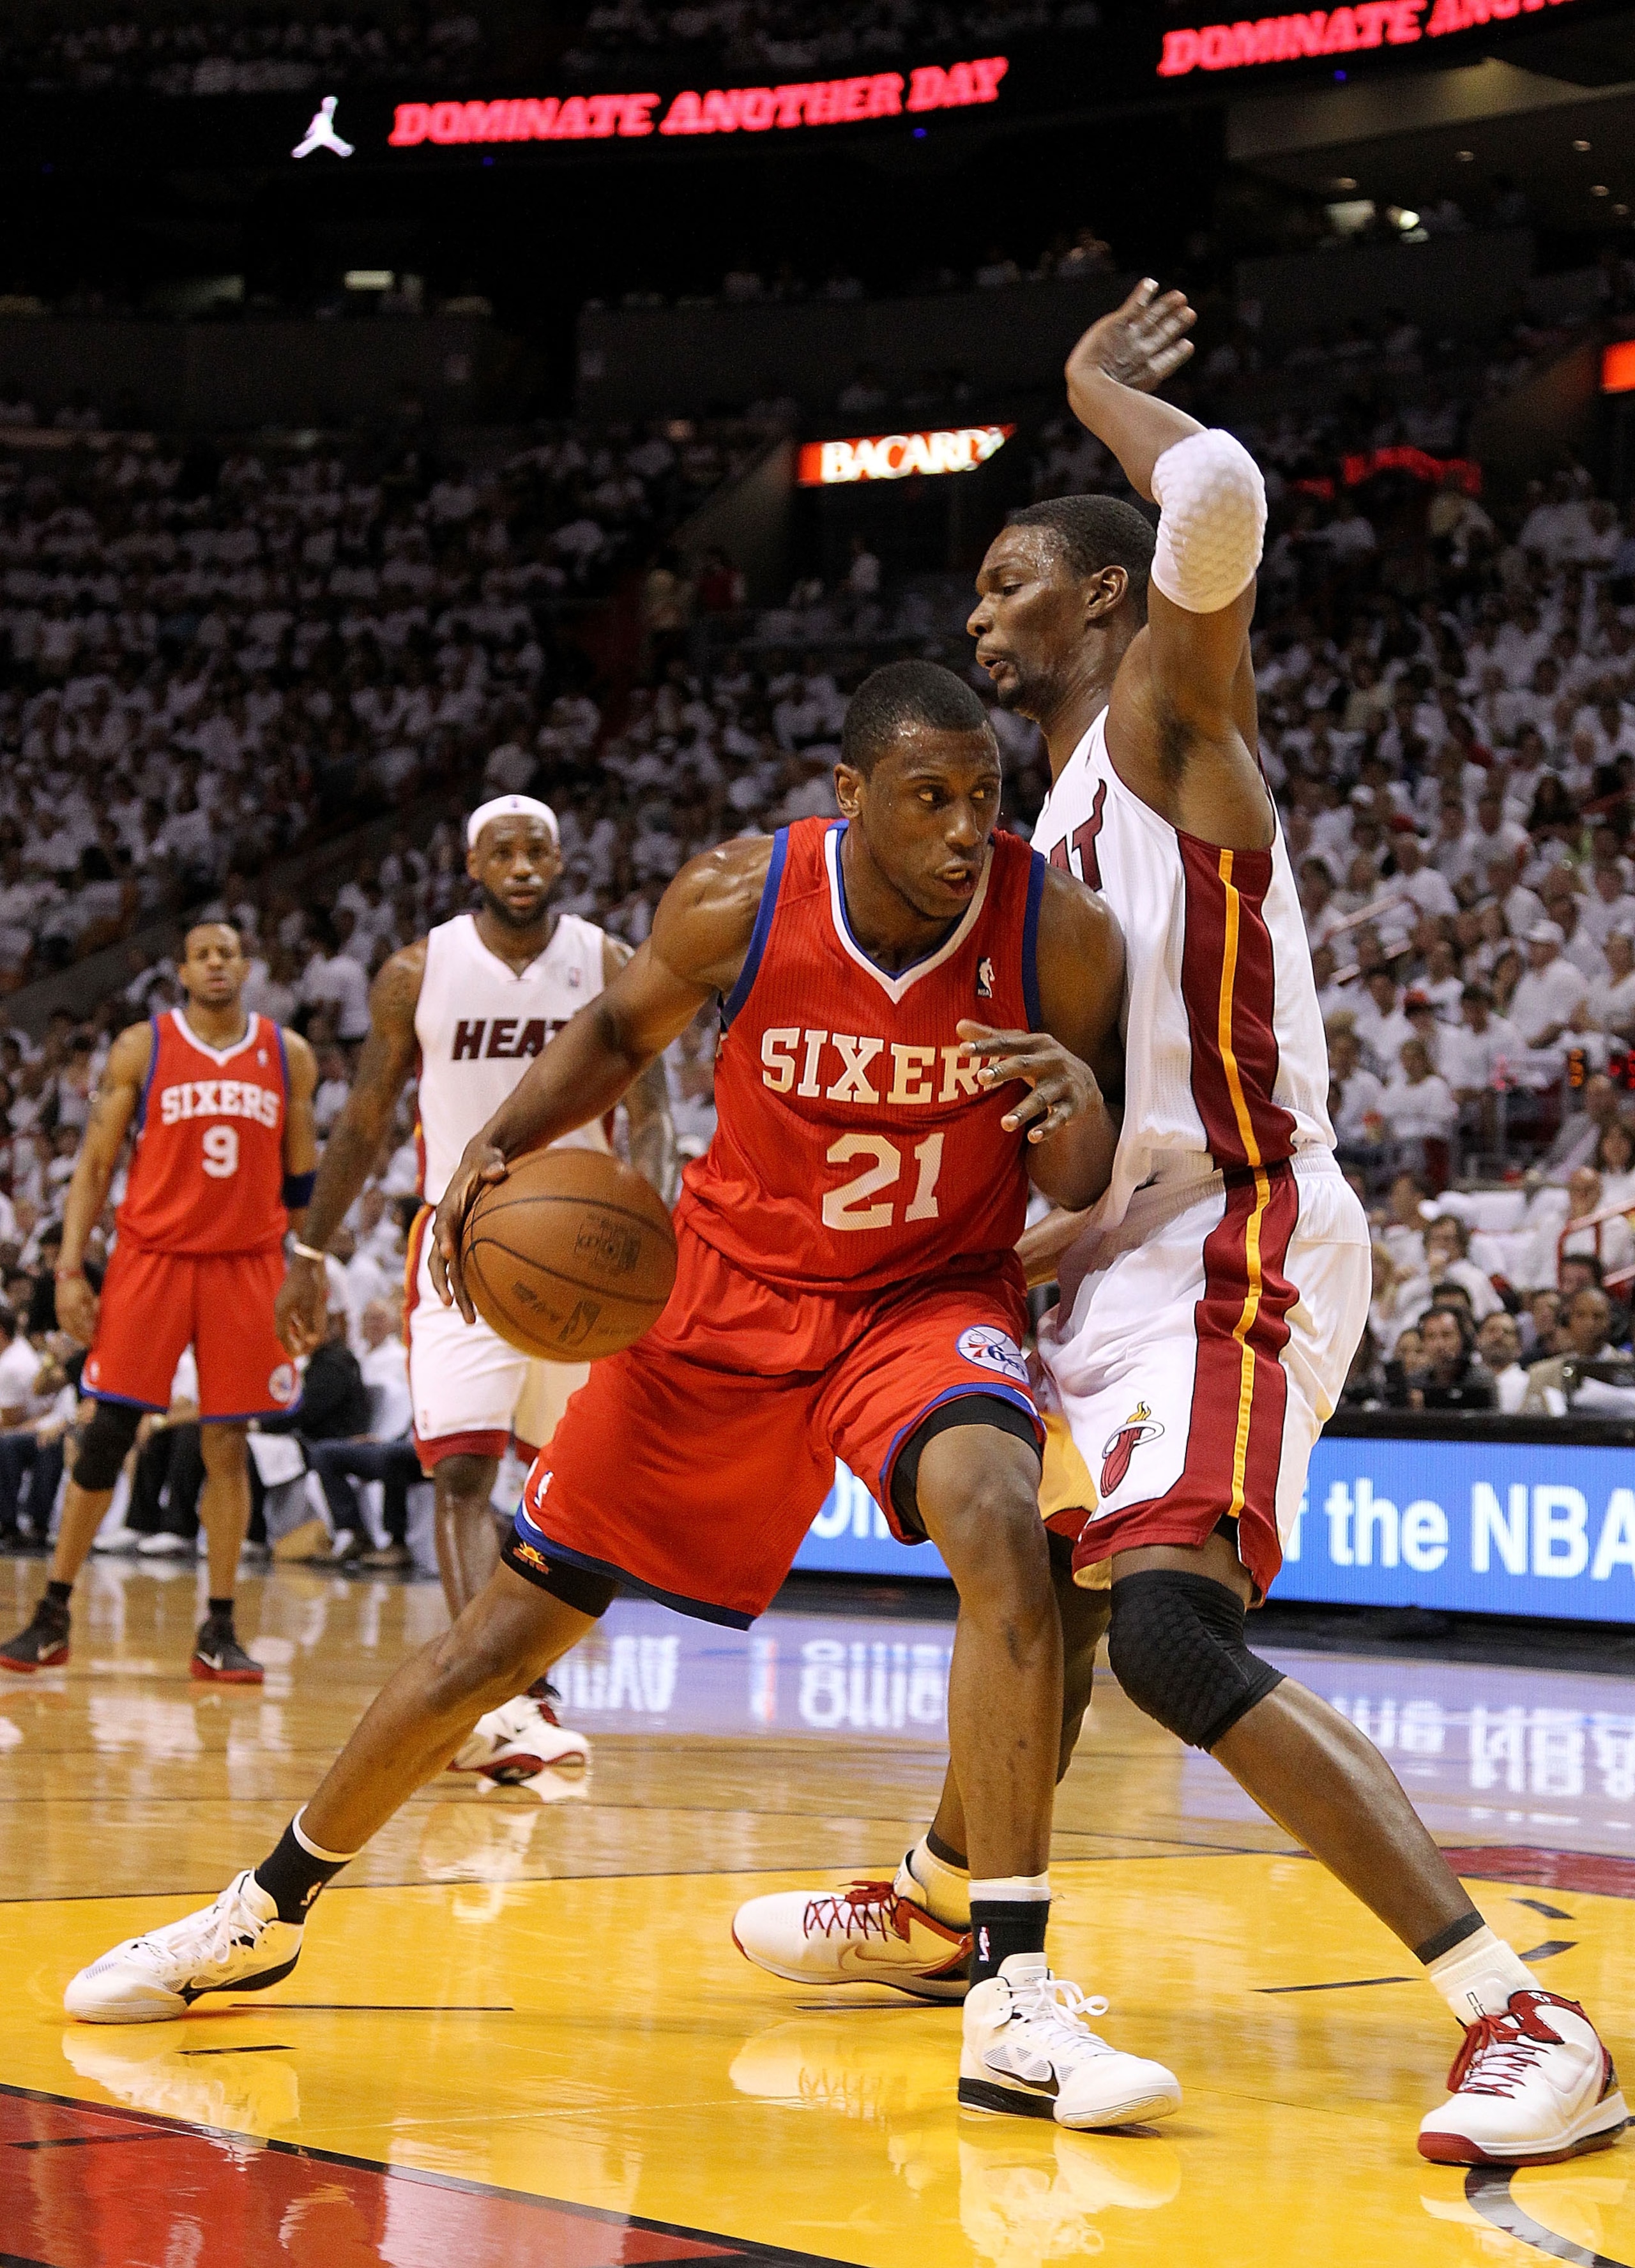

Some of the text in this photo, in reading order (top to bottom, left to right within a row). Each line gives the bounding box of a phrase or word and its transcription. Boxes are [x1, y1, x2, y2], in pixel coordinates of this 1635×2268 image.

[1157, 0, 1428, 77] DOMINATE
[387, 56, 1009, 147] DOMINATE ANOTHER DAY
[161, 1079, 280, 1129] SIXERS
[202, 1124, 239, 1179] 9
[822, 1132, 945, 1232] 21
[1324, 1477, 1449, 1573] the
[1472, 1482, 1635, 1582] NBA
